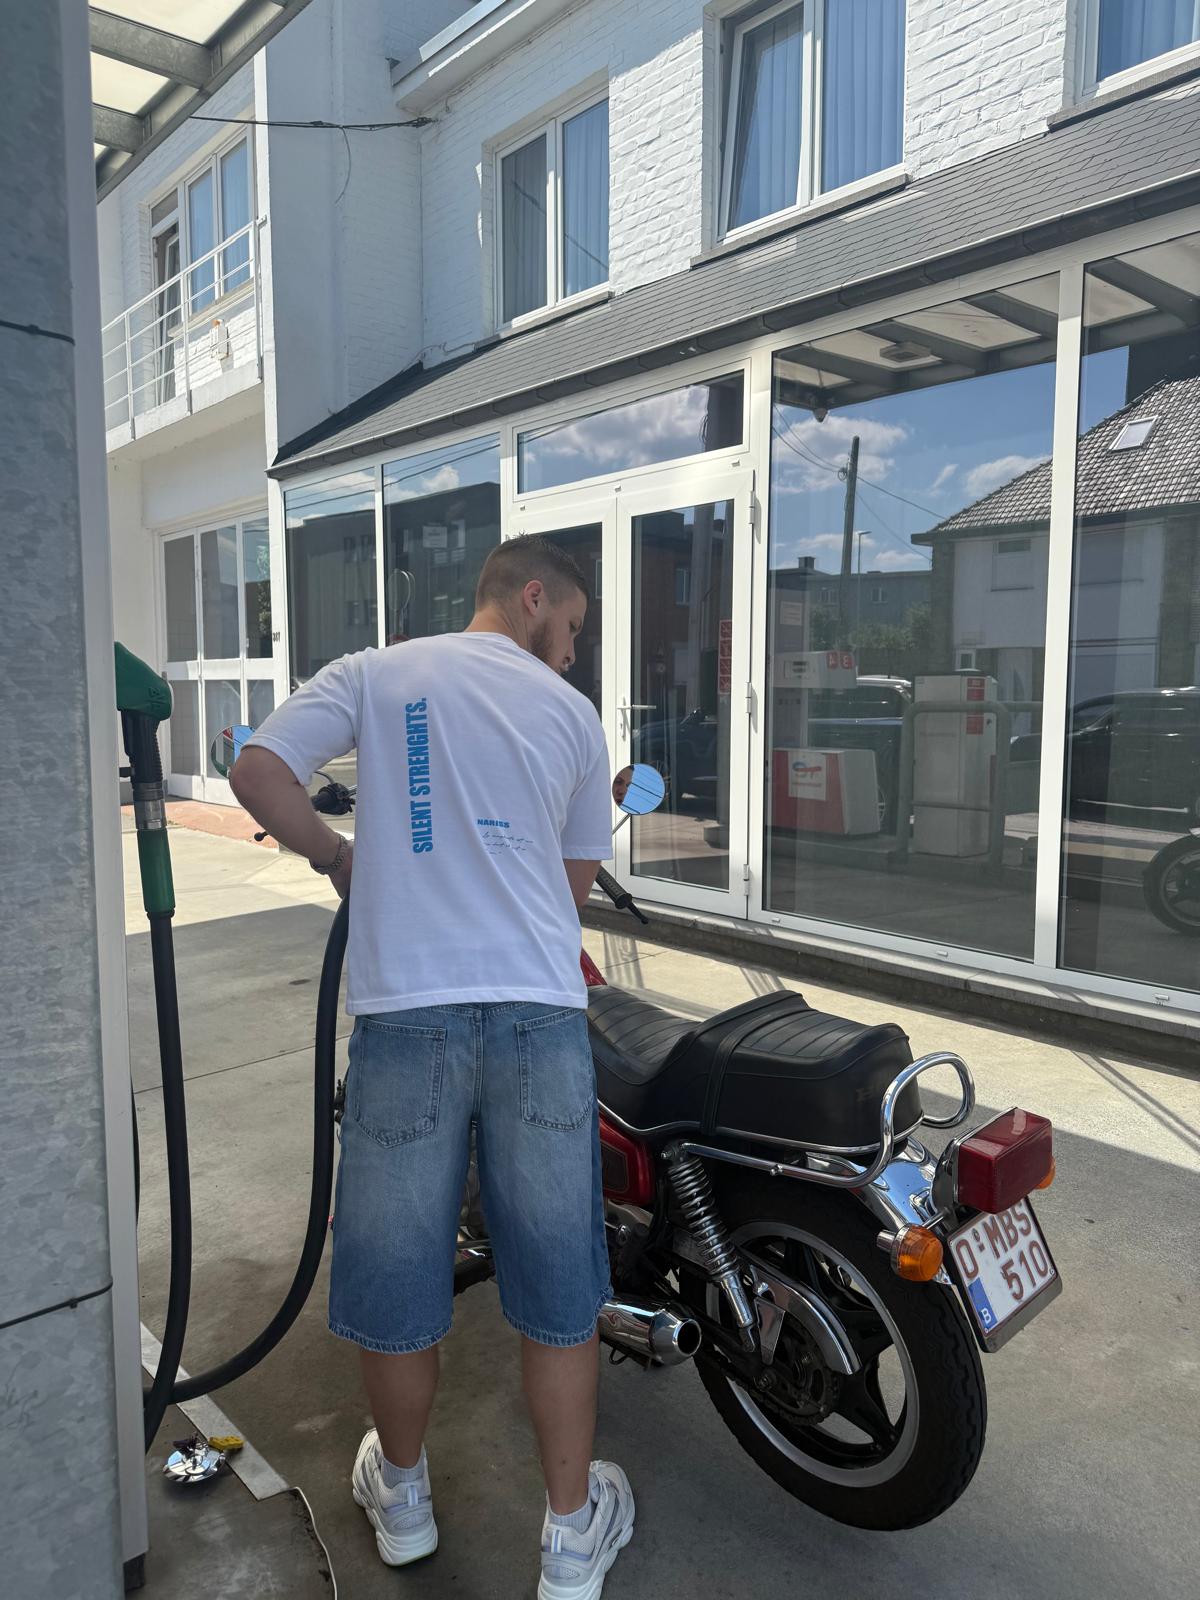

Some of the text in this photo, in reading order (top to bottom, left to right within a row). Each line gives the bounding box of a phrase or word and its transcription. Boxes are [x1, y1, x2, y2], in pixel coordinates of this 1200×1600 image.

[405, 698, 433, 853] SILENT STRENGHTS.
[1000, 1240, 1049, 1301] 510
[980, 1307, 992, 1324] B
